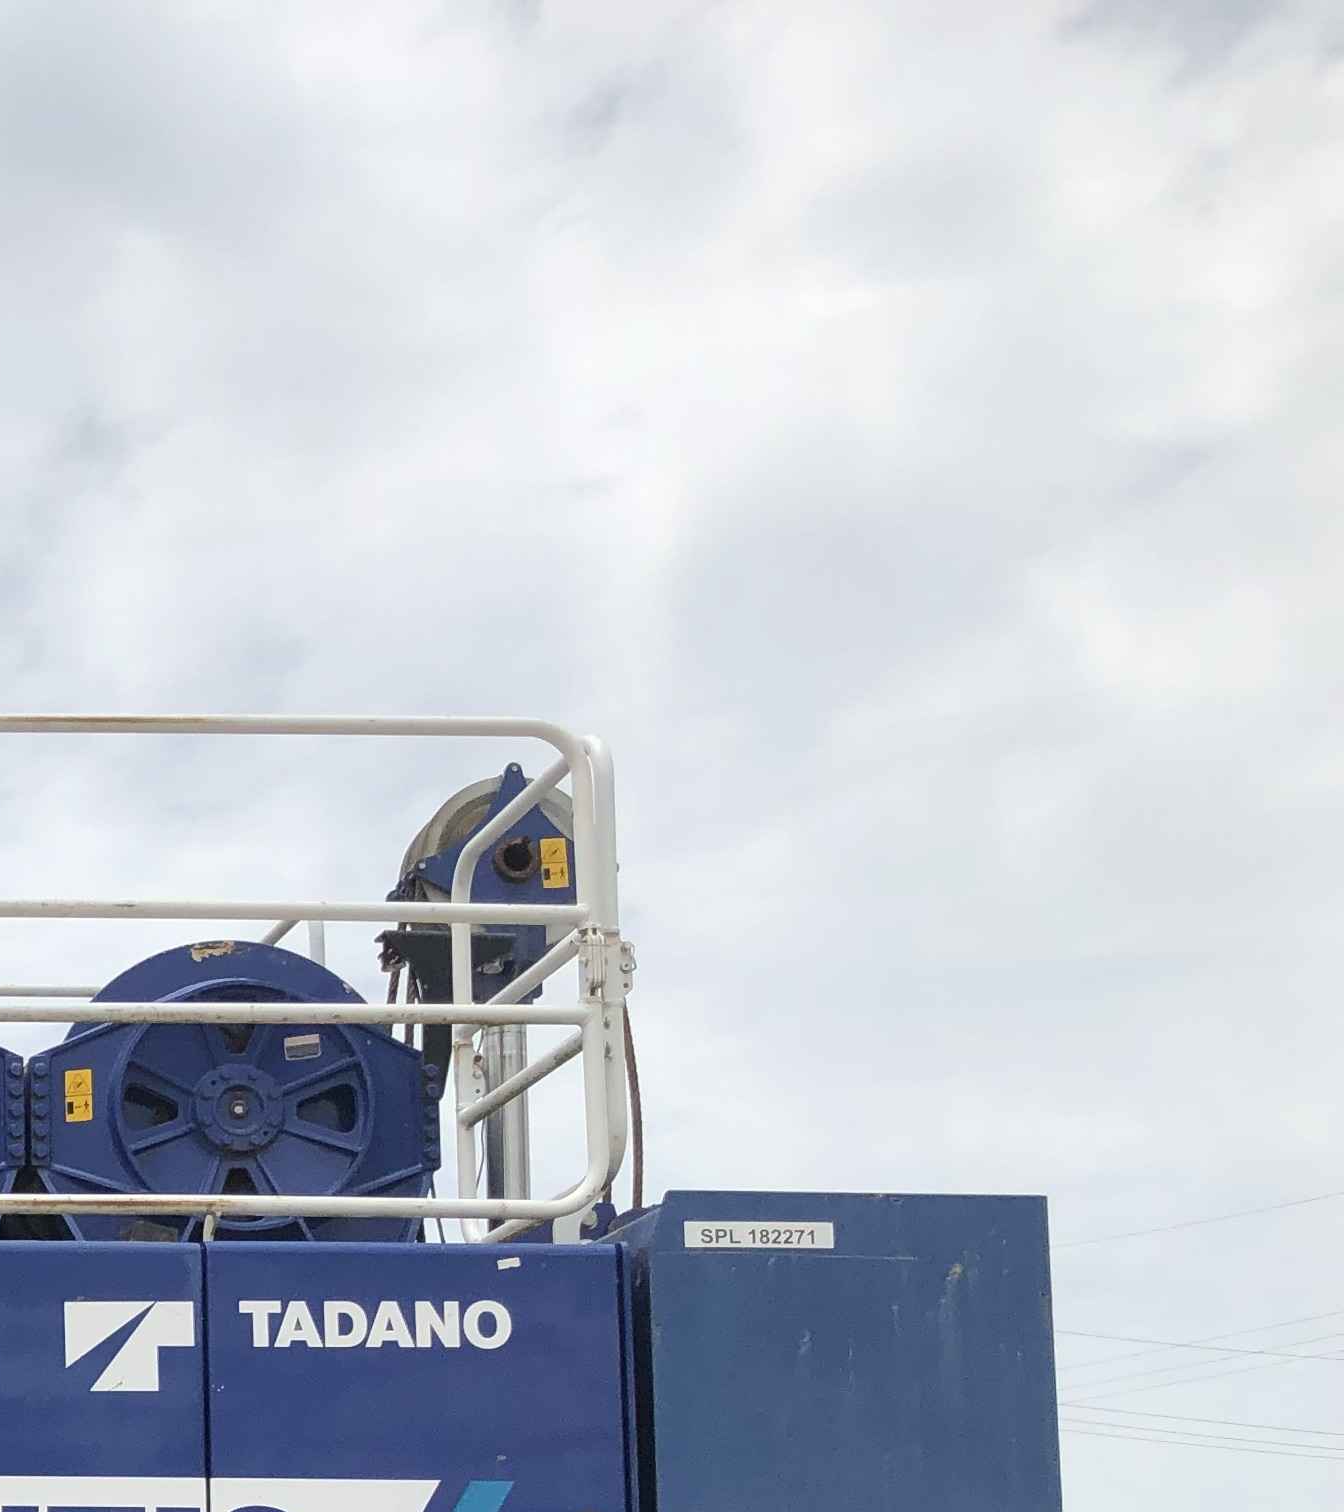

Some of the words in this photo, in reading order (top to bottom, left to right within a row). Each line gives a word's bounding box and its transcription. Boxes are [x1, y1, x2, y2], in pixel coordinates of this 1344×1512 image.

[700, 1228, 742, 1244] SPL
[747, 1228, 816, 1245] 182271
[238, 1299, 513, 1350] TADANO
